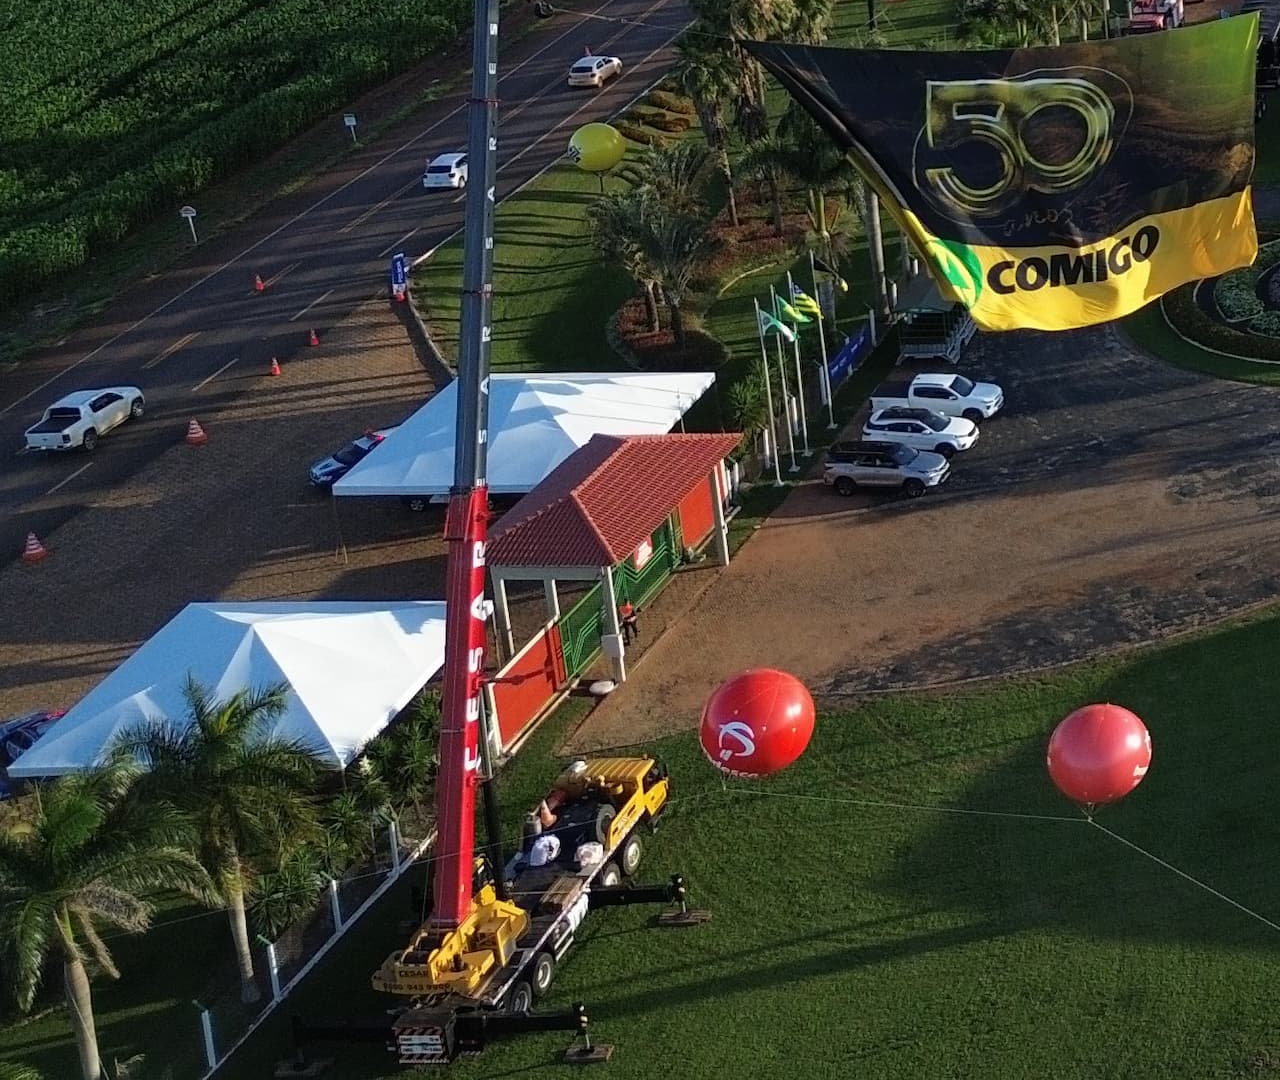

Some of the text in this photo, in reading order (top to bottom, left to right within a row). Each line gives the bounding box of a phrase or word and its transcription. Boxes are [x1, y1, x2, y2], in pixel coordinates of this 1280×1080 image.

[926, 78, 1116, 217] 50
[987, 225, 1161, 295] COMIGO
[464, 540, 494, 770] CESAR
